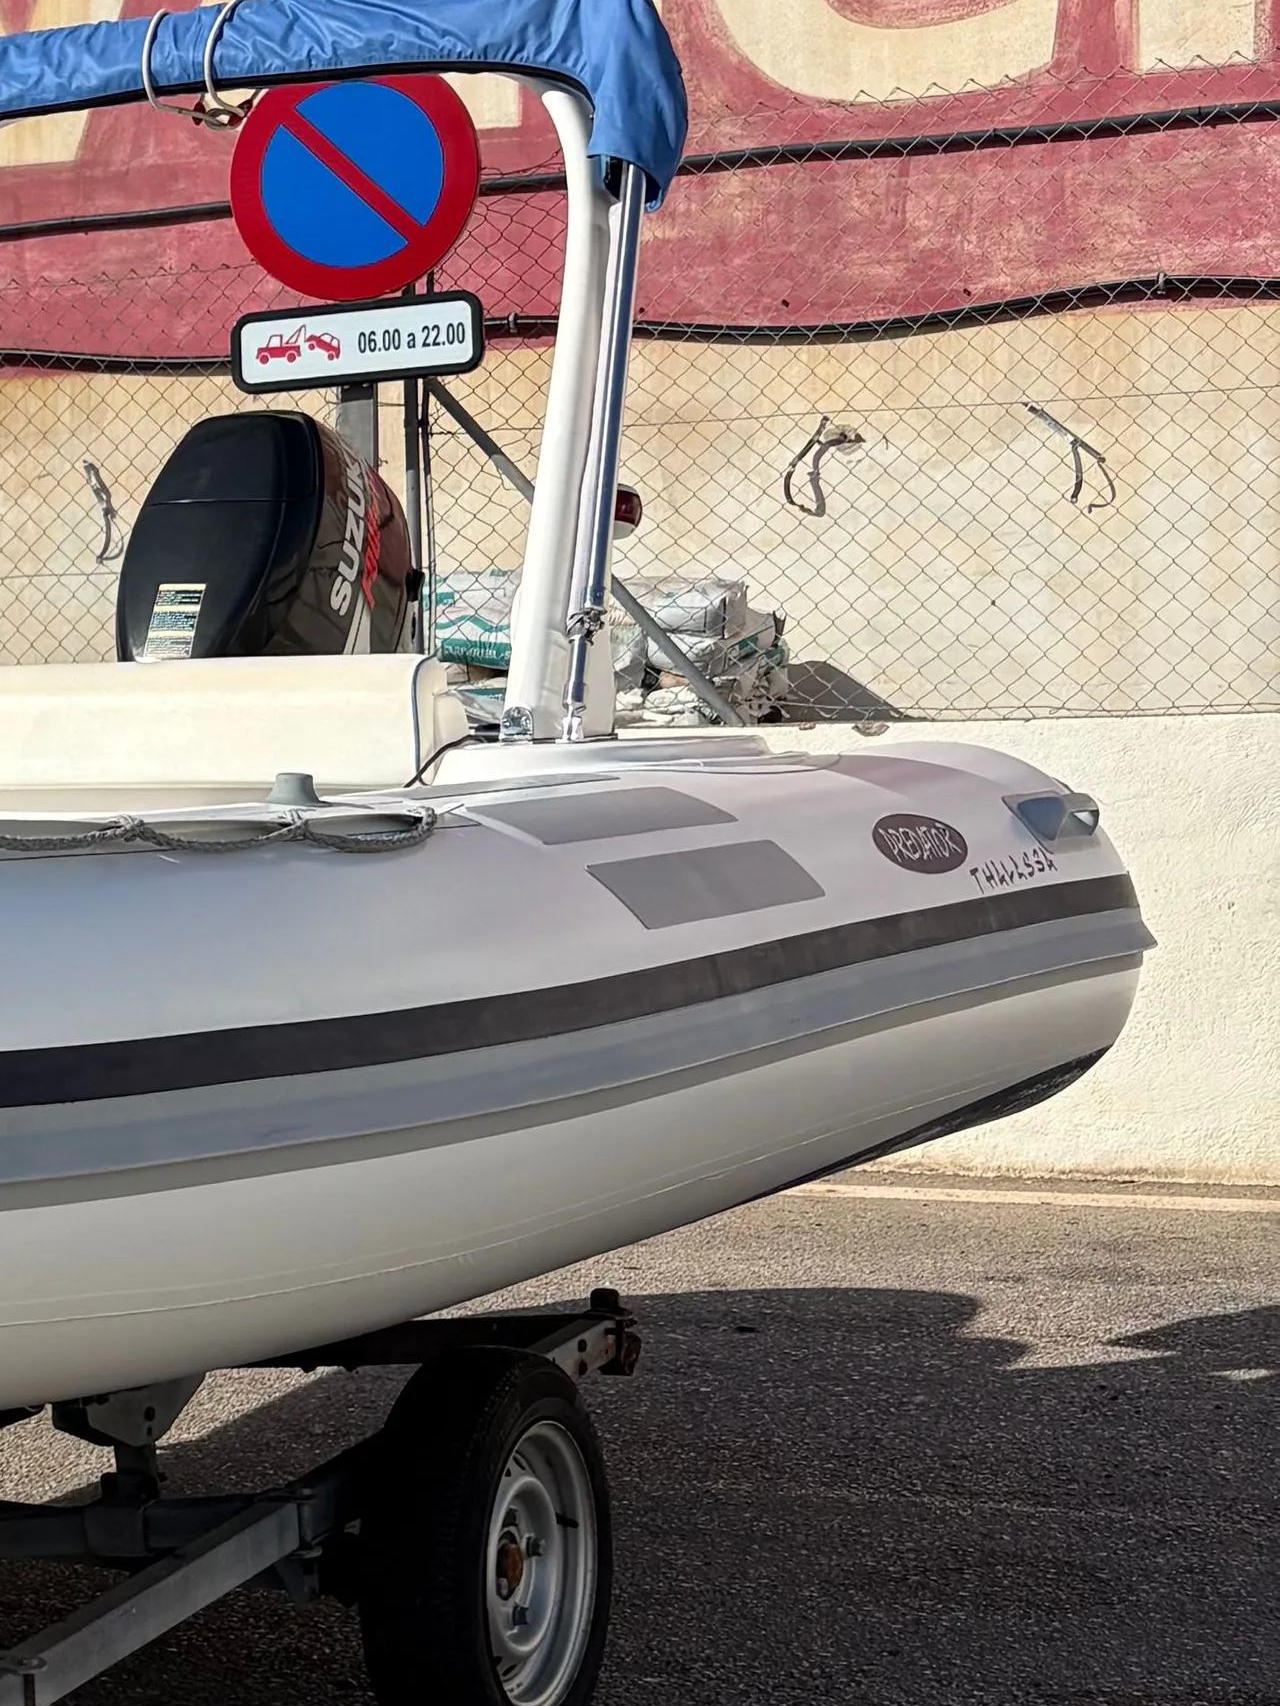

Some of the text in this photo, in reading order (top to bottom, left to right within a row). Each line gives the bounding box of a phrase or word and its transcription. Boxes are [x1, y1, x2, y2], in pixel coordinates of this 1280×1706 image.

[357, 321, 466, 354] 06.00 a 22.00
[878, 822, 963, 863] PREDATOR
